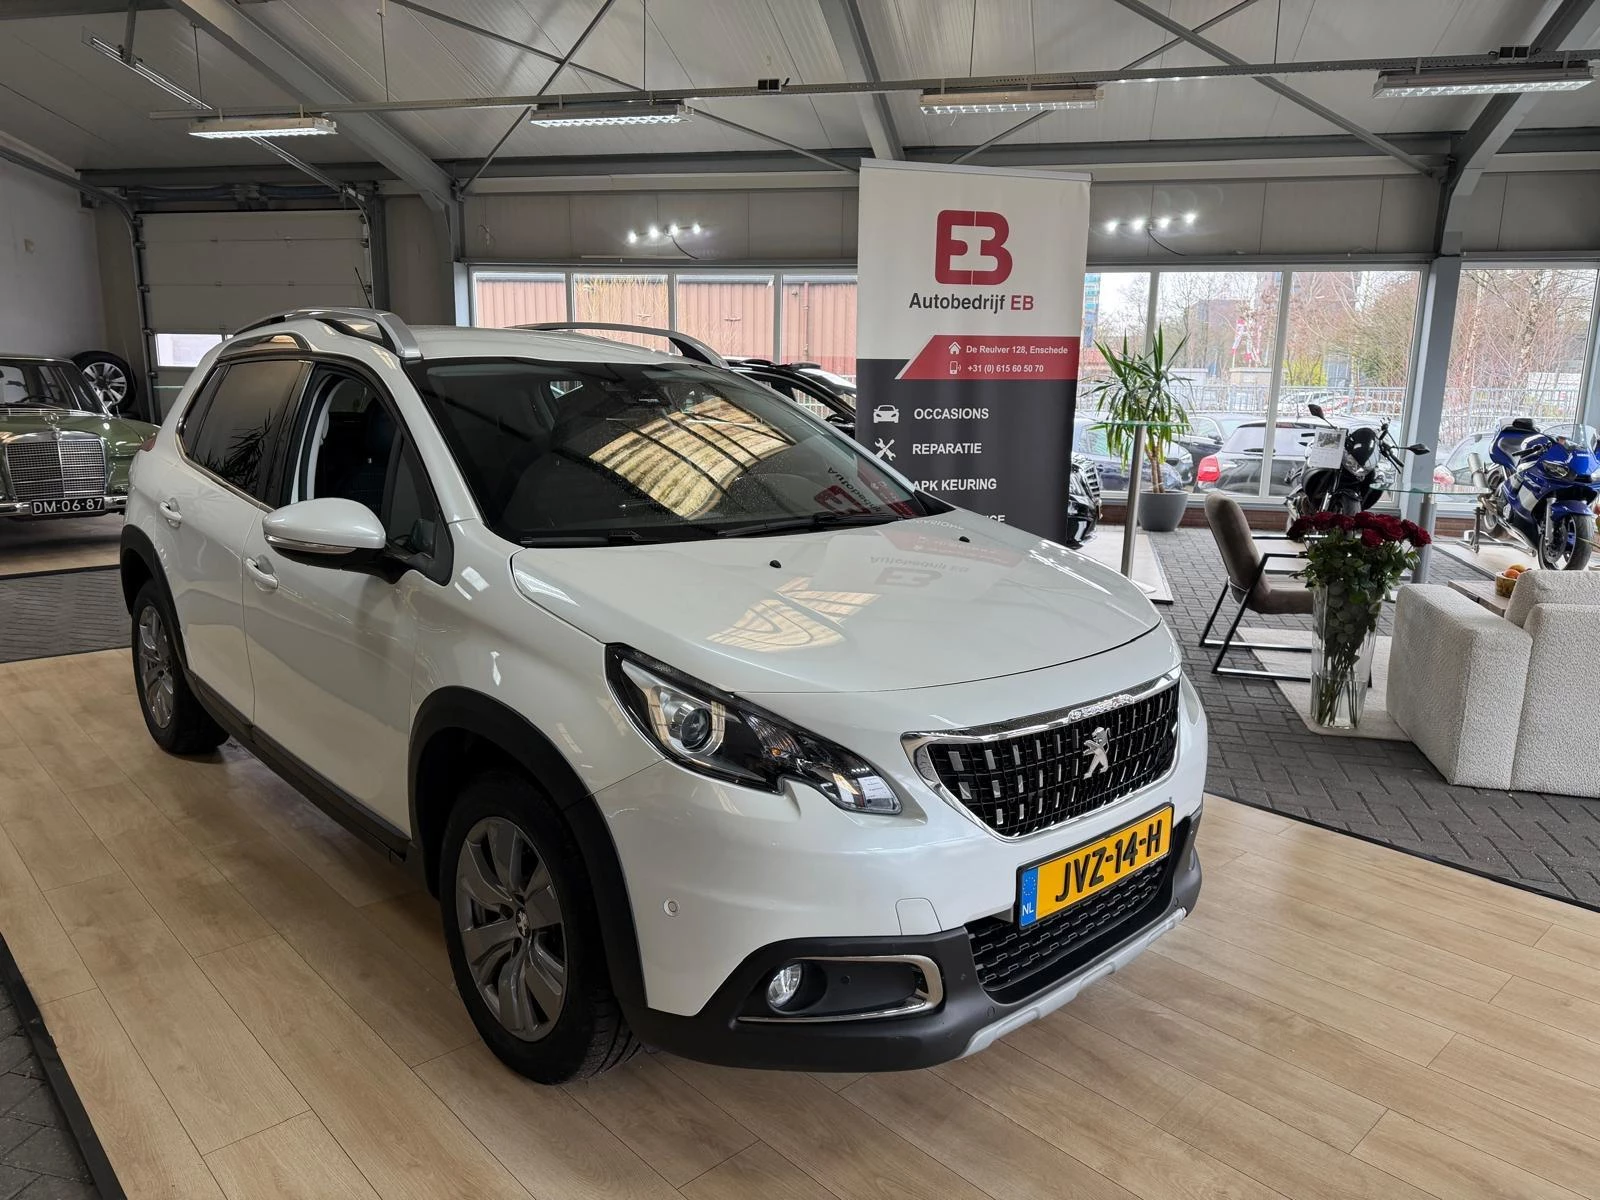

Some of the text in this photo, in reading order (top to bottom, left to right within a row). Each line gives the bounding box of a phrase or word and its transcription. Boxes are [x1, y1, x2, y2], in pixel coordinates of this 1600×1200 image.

[935, 209, 1013, 285] EB
[909, 292, 1034, 314] Autobedrijf EB
[966, 345, 1069, 355] De Reulver 128, Enschede
[968, 364, 982, 372] +31
[984, 364, 995, 374] (0)
[996, 364, 1011, 373] 615
[1023, 364, 1033, 372] 50
[1035, 364, 1044, 372] 70
[914, 408, 990, 420] OCCASIONS
[912, 442, 982, 455] REPARATIE
[913, 478, 997, 491] APK KEURING
[33, 498, 103, 514] DM-06-87
[1055, 819, 1163, 902] JVZ-14-H
[1022, 902, 1034, 916] NL
